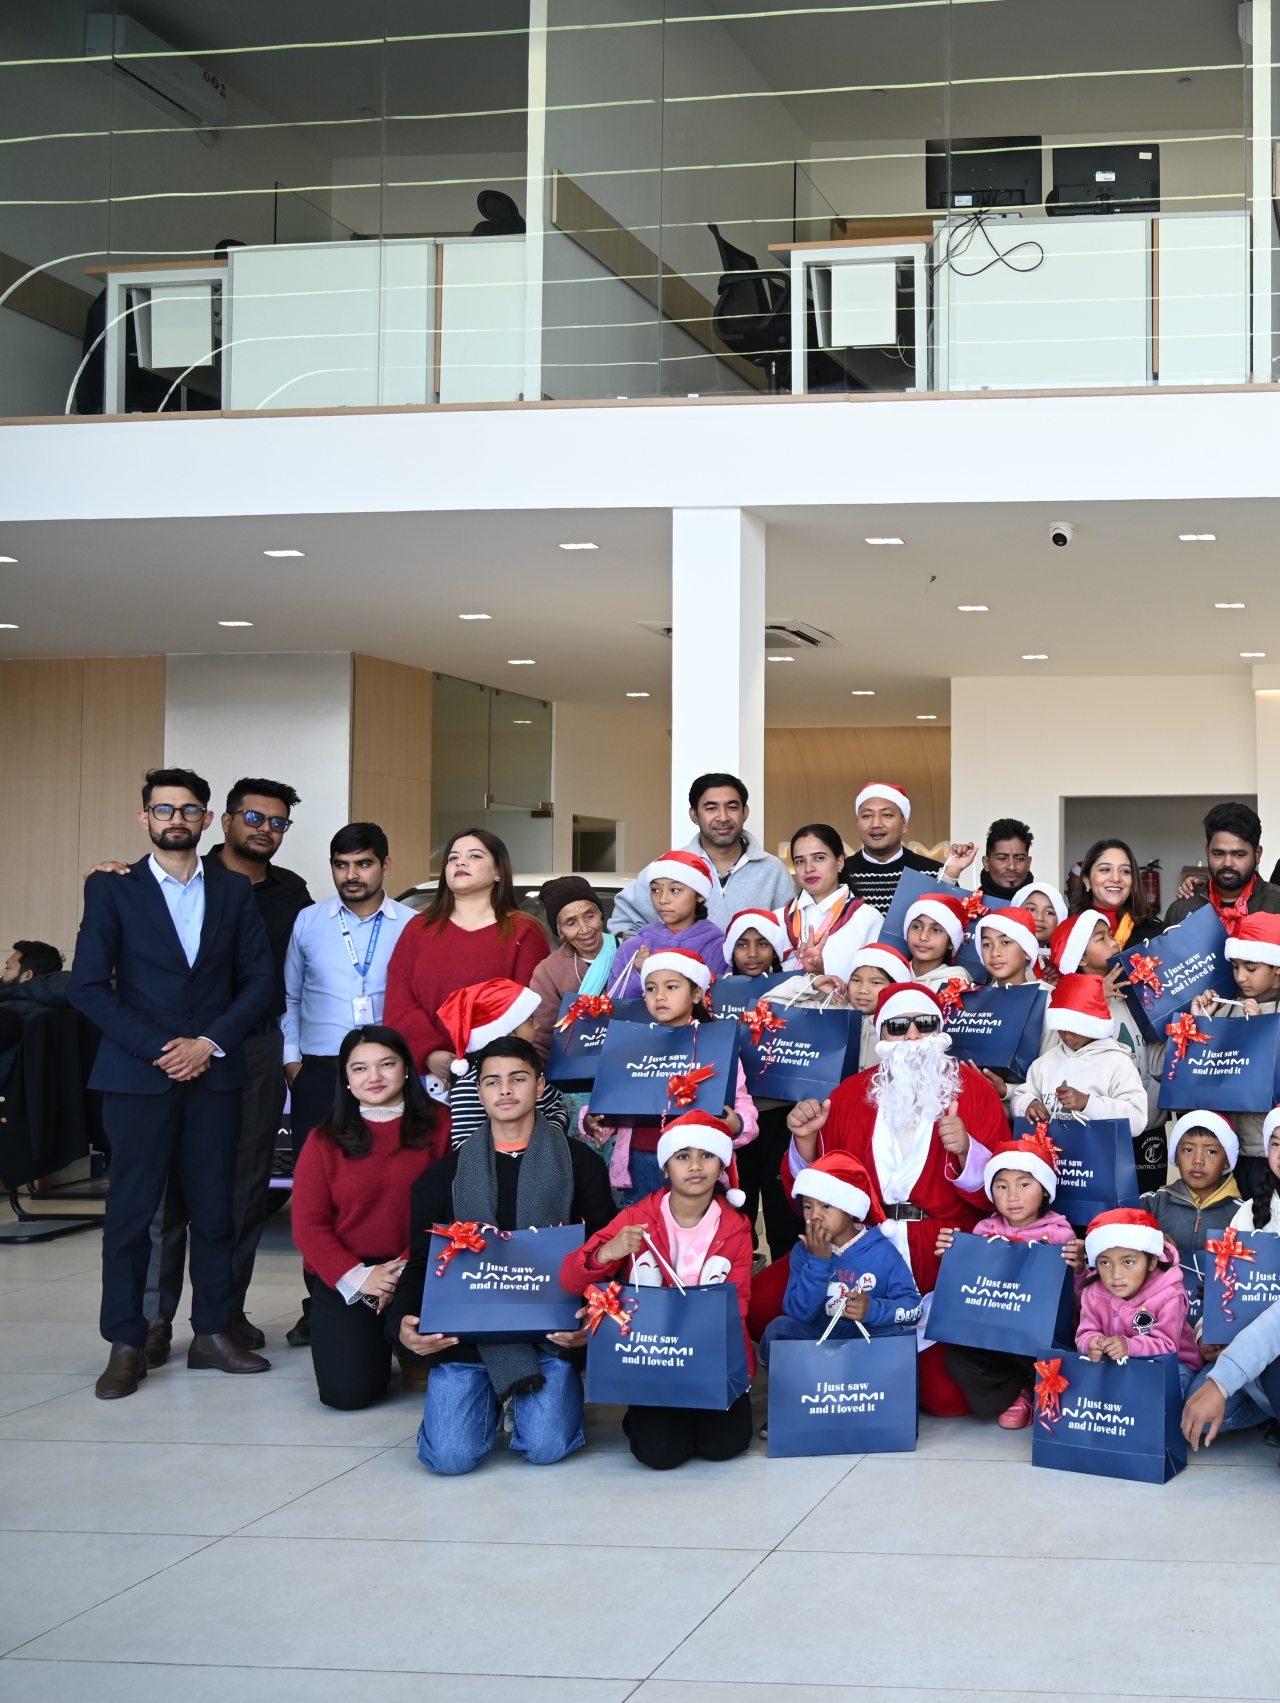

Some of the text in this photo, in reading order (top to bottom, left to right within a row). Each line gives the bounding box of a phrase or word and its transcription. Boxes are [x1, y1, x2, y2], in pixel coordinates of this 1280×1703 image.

[1168, 963, 1185, 977] just
[1185, 952, 1200, 966] saw
[1161, 953, 1216, 991] NAMMI
[1170, 983, 1185, 995] and
[1188, 968, 1209, 983] loved
[776, 1039, 794, 1047] just
[758, 1045, 819, 1058] NAMMI
[1207, 1050, 1223, 1059] just
[648, 1055, 667, 1064] just
[781, 1056, 802, 1066] loved
[1188, 1058, 1249, 1066] NAMMI
[1214, 1067, 1233, 1075] loved
[1058, 1168, 1093, 1178] MMI
[1061, 1178, 1080, 1186] loved
[1081, 1179, 1086, 1187] it
[480, 1262, 484, 1270] I
[487, 1262, 509, 1272] just
[462, 1272, 550, 1282] NAMMI
[976, 1276, 981, 1284] I
[981, 1277, 1001, 1288] just
[1250, 1271, 1253, 1280] I
[1256, 1271, 1276, 1282] just
[470, 1281, 491, 1290] and
[500, 1282, 529, 1290] loved
[961, 1285, 1031, 1302] NAMMI
[1242, 1292, 1260, 1301] and
[1263, 1293, 1266, 1301] I
[965, 1297, 1021, 1312] and I loved it
[630, 1332, 679, 1344] I just saw
[615, 1343, 693, 1356] NAMMI
[622, 1356, 684, 1366] and I loved it
[817, 1382, 821, 1392] I
[824, 1382, 845, 1393] just
[801, 1392, 884, 1403] NAMMI
[809, 1403, 876, 1414] and I loved it
[1077, 1397, 1122, 1412] I just saw
[1062, 1408, 1134, 1426] NAMMI
[1068, 1421, 1126, 1436] and I loved it
